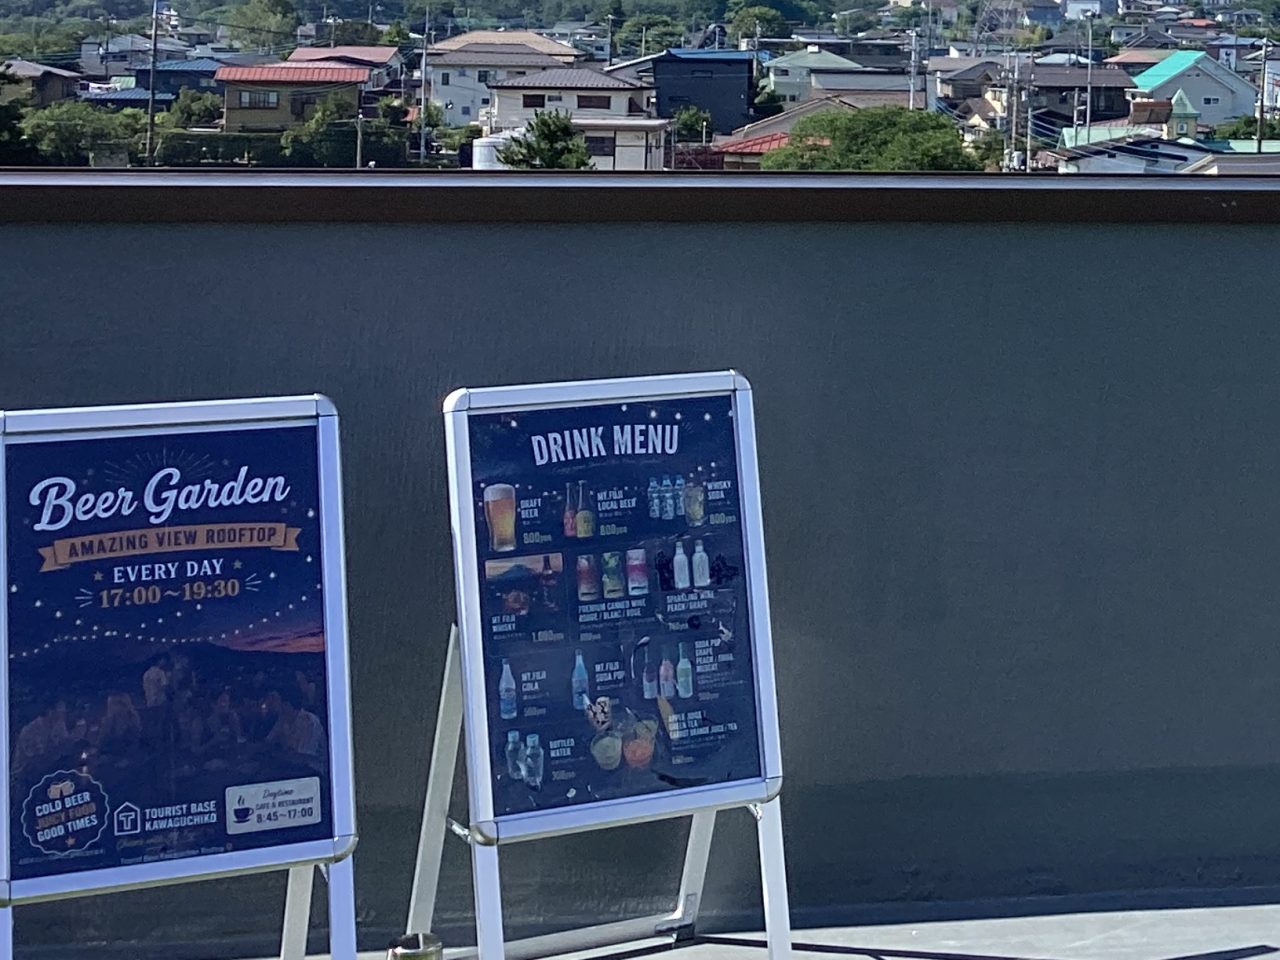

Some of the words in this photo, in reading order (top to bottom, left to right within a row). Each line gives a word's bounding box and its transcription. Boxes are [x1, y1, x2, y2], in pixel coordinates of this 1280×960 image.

[531, 426, 607, 466] DRINK
[613, 424, 679, 455] MENU
[29, 476, 138, 531] Beer
[143, 465, 291, 524] Garden
[520, 498, 541, 509] DRAFT
[598, 501, 618, 511] LOCAL
[620, 497, 637, 508] BEER
[521, 508, 539, 519] BEER
[68, 533, 149, 559] AMAZING
[155, 528, 197, 548] VIEW
[205, 526, 278, 544] ROOFTOP
[113, 562, 179, 583] EVERY
[186, 558, 225, 577] DAY
[35, 800, 62, 816] COLD
[64, 792, 90, 808] BEER
[144, 804, 187, 819] TOURIST
[190, 800, 217, 814] BASE
[37, 825, 65, 842] GOOD
[67, 814, 98, 832] TIMES
[145, 812, 217, 831] KAWAGUCHIKO
